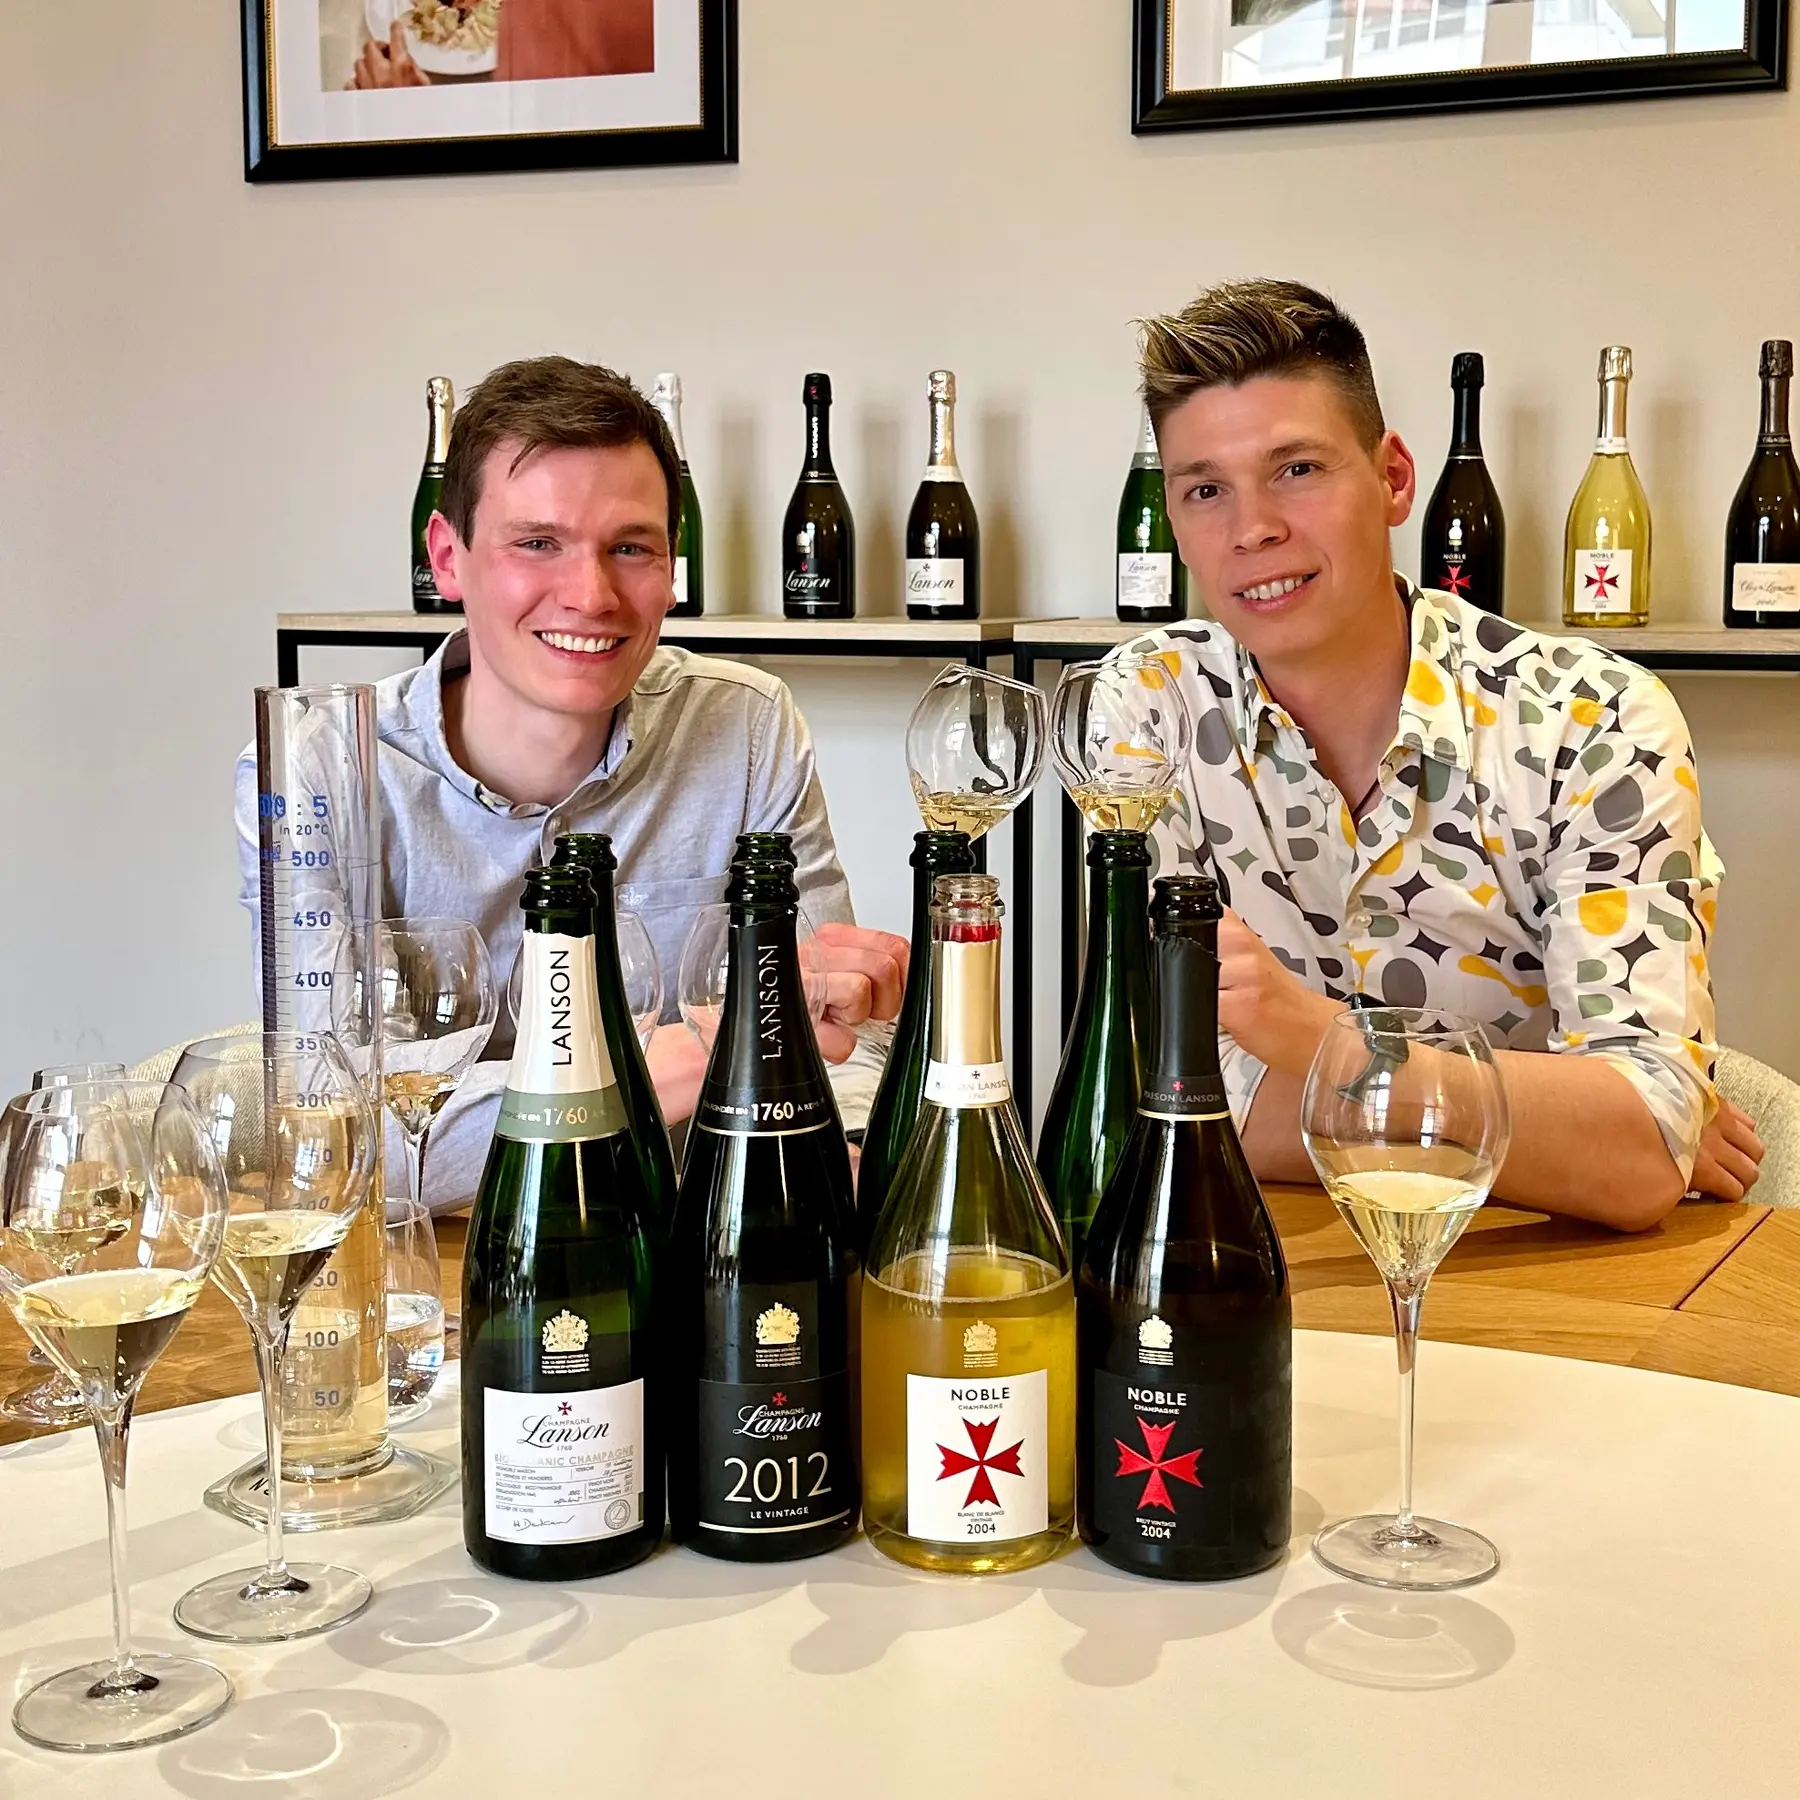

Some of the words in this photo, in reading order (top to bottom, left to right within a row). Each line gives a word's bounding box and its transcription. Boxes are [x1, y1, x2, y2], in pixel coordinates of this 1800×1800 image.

[784, 569, 831, 592] Lanson
[907, 569, 955, 592] Lanson
[291, 850, 330, 867] 500
[293, 910, 332, 927] 450
[294, 970, 333, 988] 400
[549, 949, 573, 1067] LANSON
[757, 944, 783, 1061] LANSON
[295, 1037, 329, 1051] 350
[296, 1093, 332, 1108] 300
[543, 1106, 588, 1126] 1760
[750, 1101, 795, 1121] 1760
[313, 1270, 338, 1288] 50
[305, 1329, 339, 1347] 100
[314, 1388, 340, 1407] 50
[951, 1386, 1011, 1402] NOBLE
[1127, 1386, 1188, 1407] NOBLE
[759, 1406, 806, 1418] CHAMPAGNE
[957, 1402, 1004, 1411] CHAMPAGNE
[1133, 1403, 1180, 1415] CHAMPAGNE
[542, 1417, 591, 1428] CHAMPAGNE
[732, 1404, 823, 1439] Lanson
[516, 1414, 610, 1449] Lanson
[568, 1444, 634, 1465] CHAMPAGNE
[723, 1451, 833, 1503] 2012
[750, 1510, 763, 1519] LE
[764, 1506, 810, 1519] VINTAGE
[966, 1522, 996, 1535] 2004
[1141, 1524, 1172, 1540] 2004
